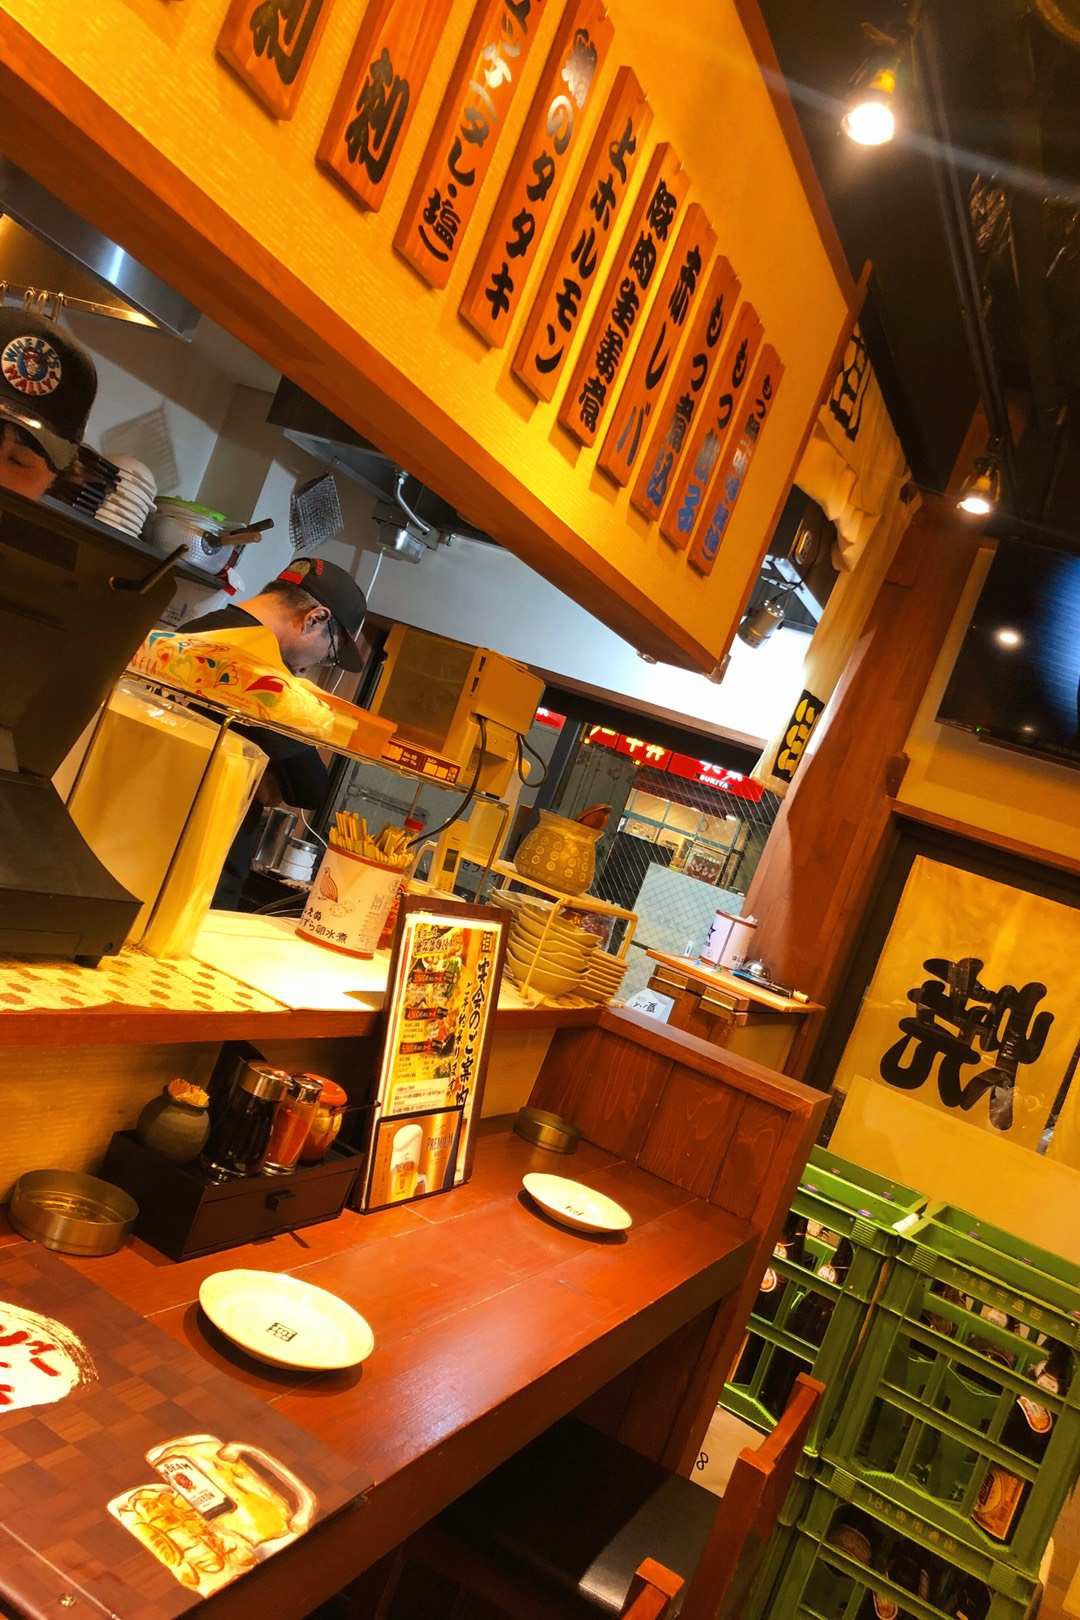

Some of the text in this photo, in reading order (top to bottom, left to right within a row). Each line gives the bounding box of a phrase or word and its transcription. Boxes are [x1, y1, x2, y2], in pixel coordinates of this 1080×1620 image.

[534, 117, 637, 374] 上ホルモン
[699, 774, 729, 789] SUKIYA
